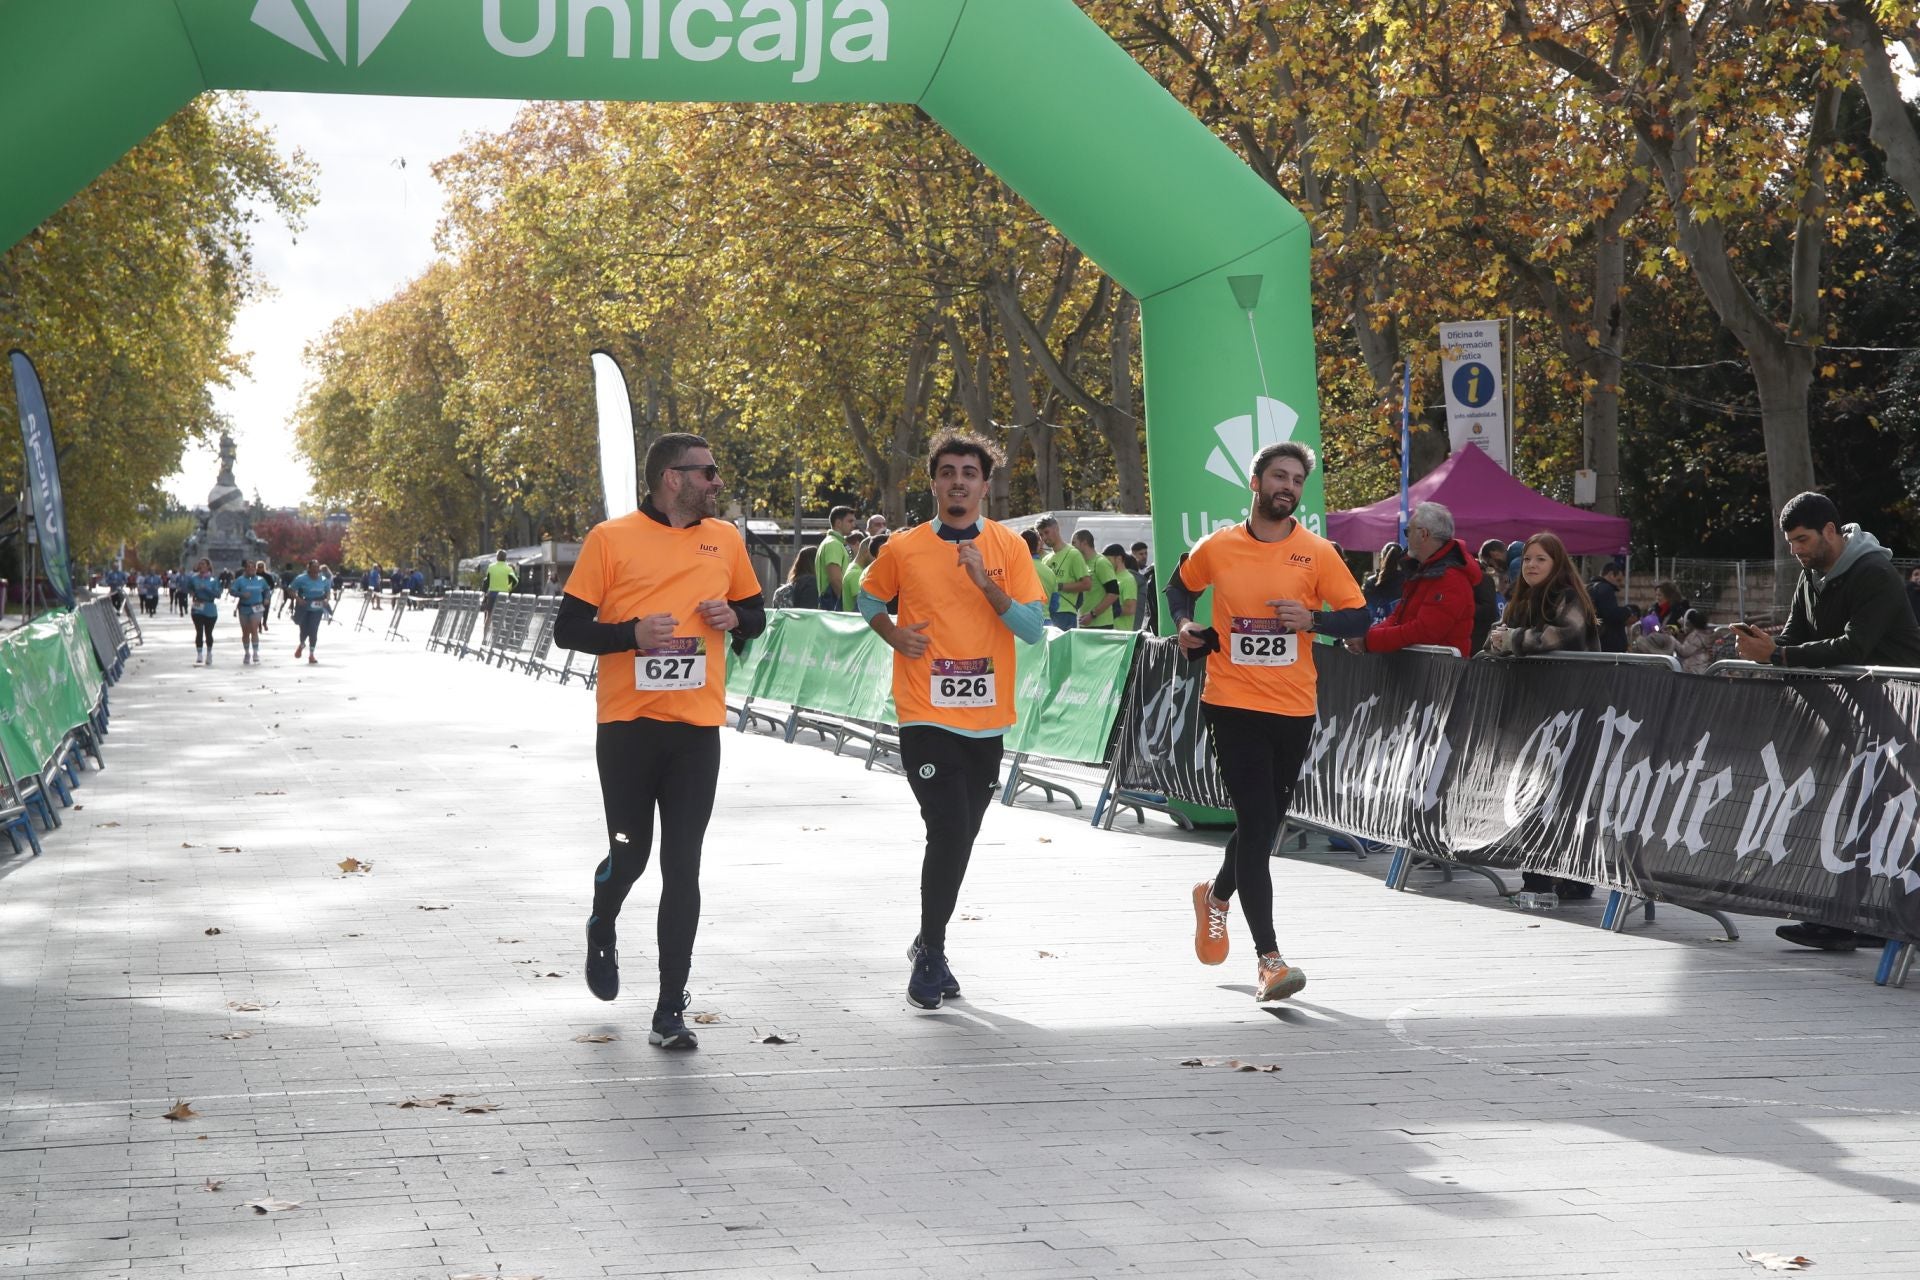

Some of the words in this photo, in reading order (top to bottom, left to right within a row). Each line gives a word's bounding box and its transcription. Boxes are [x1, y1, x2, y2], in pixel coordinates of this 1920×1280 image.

[482, 0, 889, 83] Unicaja
[1448, 331, 1473, 339] Oficina
[1474, 330, 1484, 338] de
[700, 543, 718, 553] luce
[1290, 553, 1312, 564] luce
[1240, 636, 1286, 657] 628
[645, 658, 695, 680] 627
[941, 678, 987, 697] 626
[1503, 708, 1585, 830] El
[1576, 705, 1734, 857] Norte
[1734, 741, 1816, 867] de
